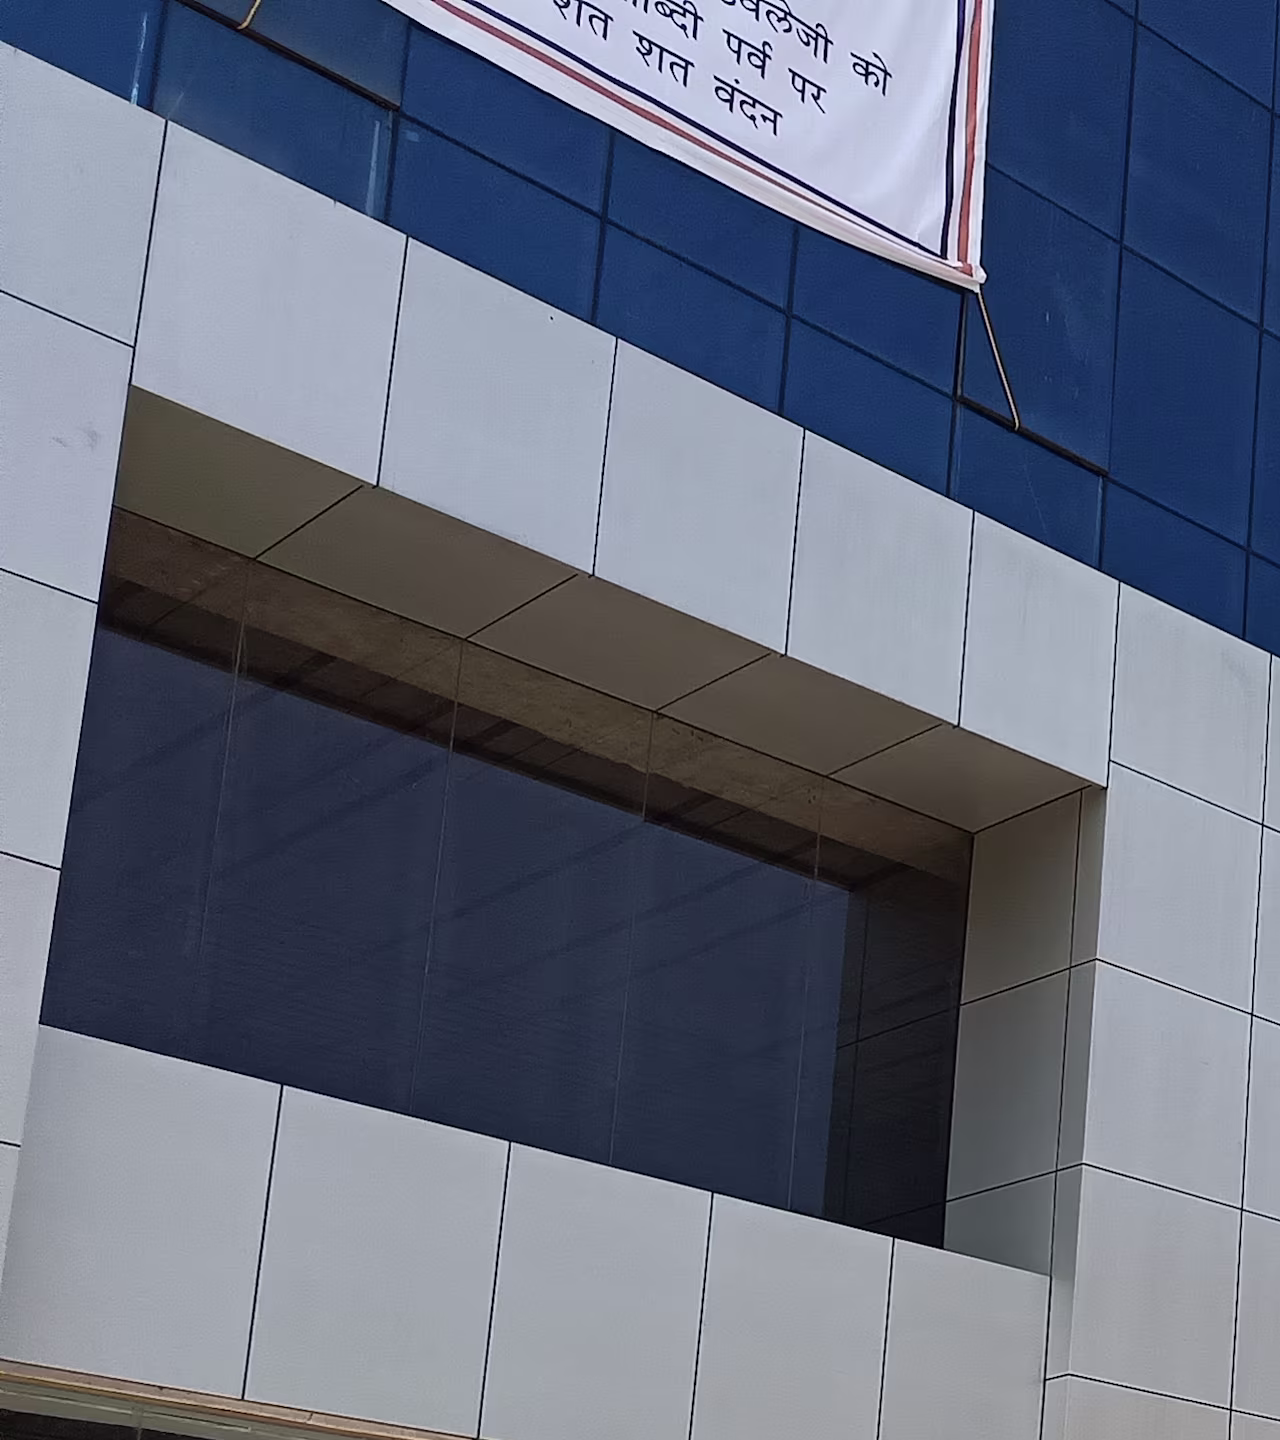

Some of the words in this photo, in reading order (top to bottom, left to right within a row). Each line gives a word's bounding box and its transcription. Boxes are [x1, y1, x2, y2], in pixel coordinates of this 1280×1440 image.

[633, 30, 695, 87] शत
[714, 75, 782, 135] वंदन
[722, 28, 772, 79] पर्व
[788, 68, 826, 114] पर
[723, 0, 833, 63] वलेजी
[851, 52, 891, 96] को
